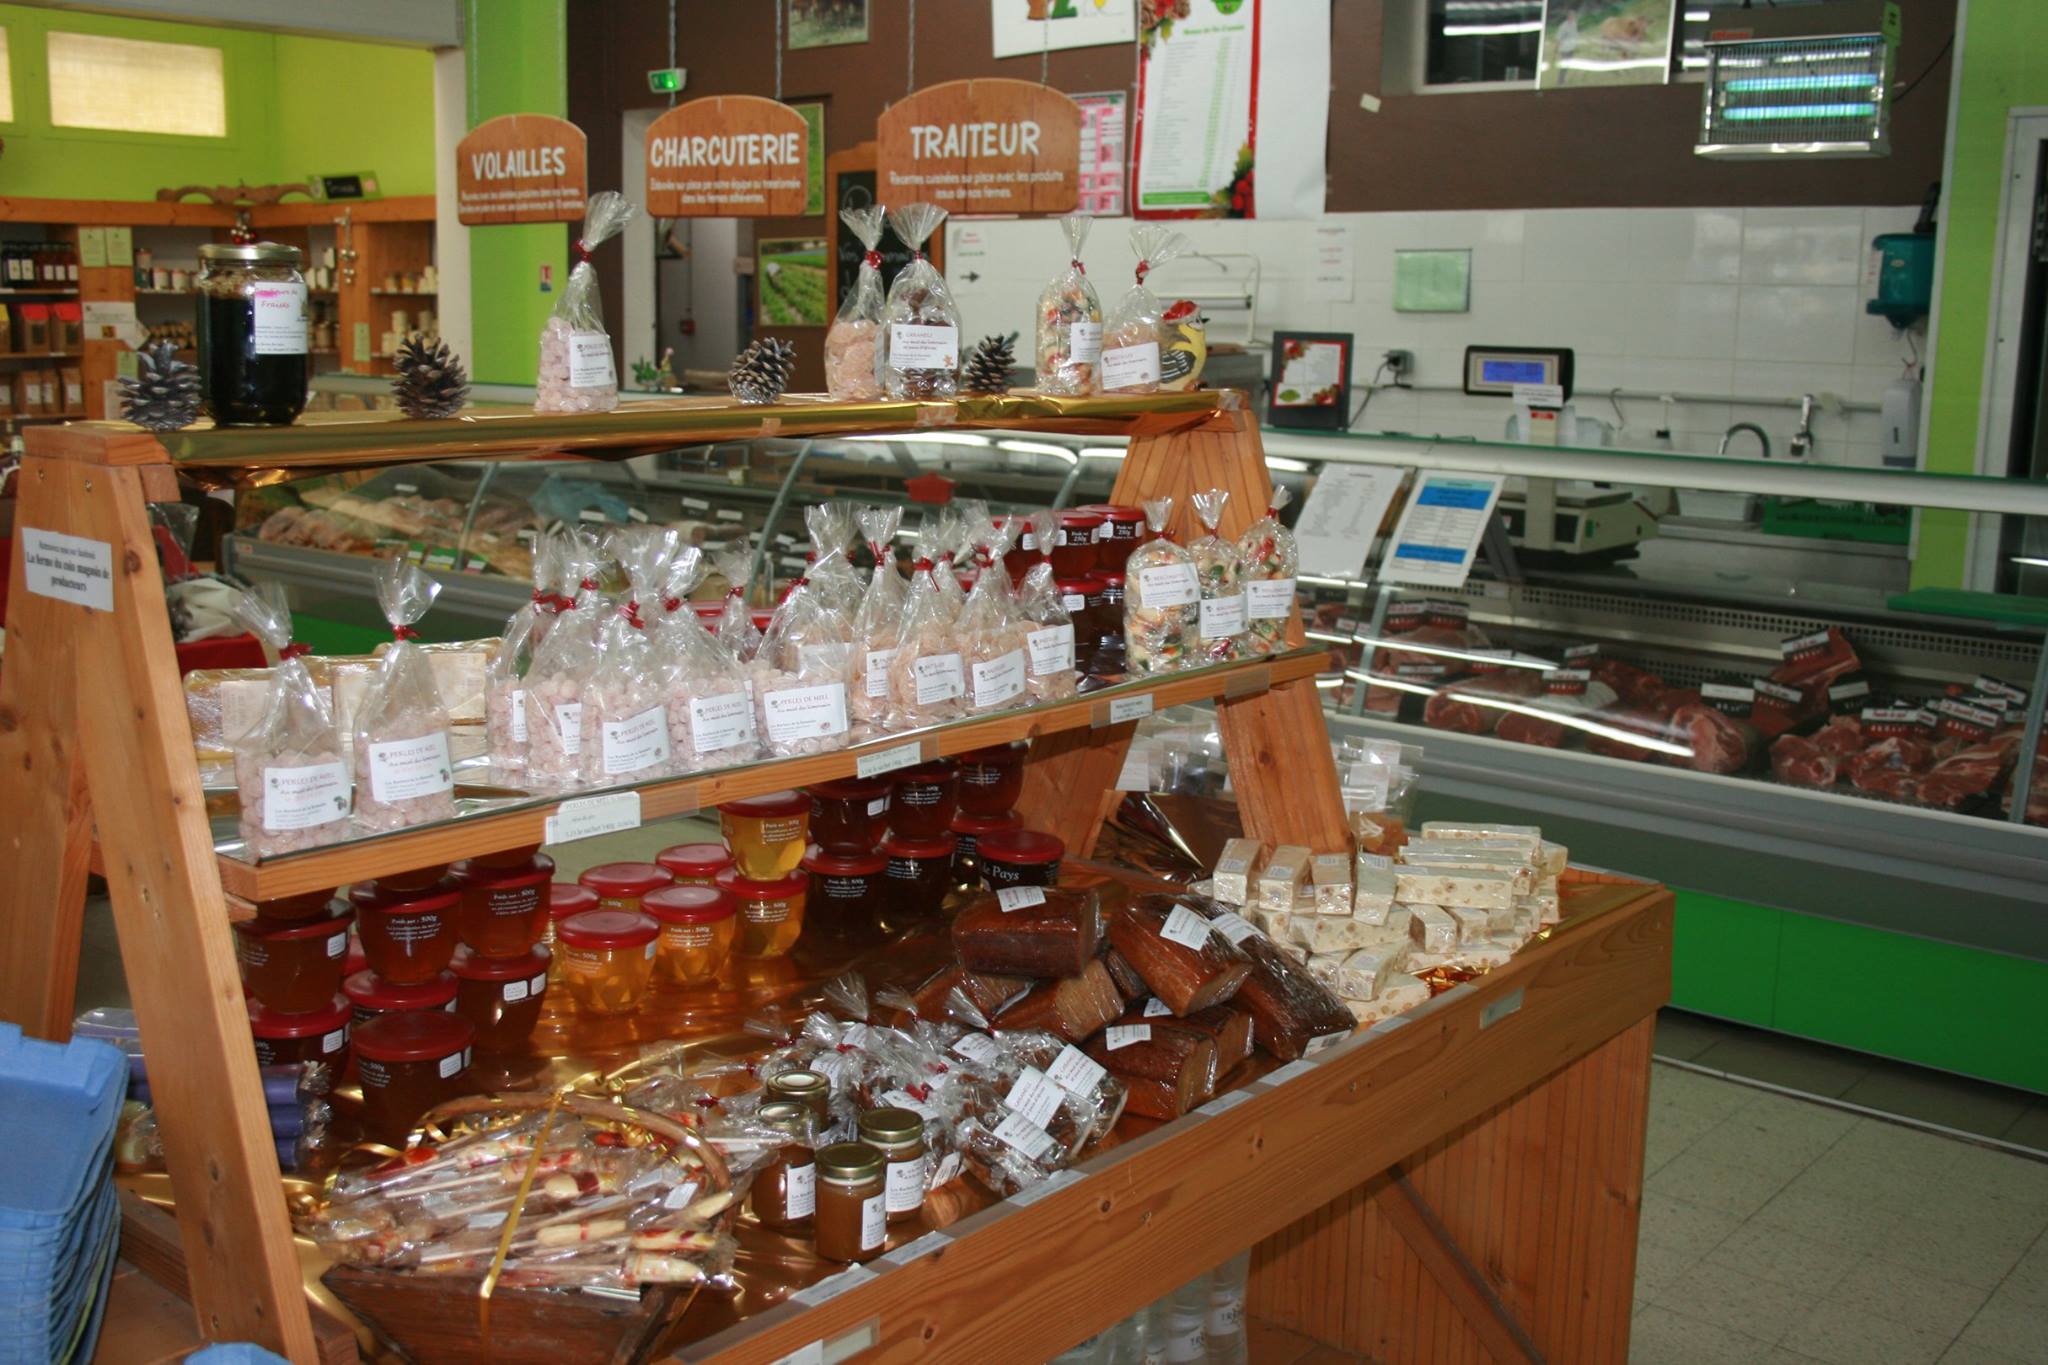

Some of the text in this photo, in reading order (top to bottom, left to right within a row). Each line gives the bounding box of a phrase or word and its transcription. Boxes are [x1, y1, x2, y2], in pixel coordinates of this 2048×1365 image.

[651, 131, 801, 168] CHARCUTERIE
[910, 120, 1041, 160] TRAITEUR
[472, 146, 567, 181] VOLAILLES
[992, 864, 1021, 882] Pays
